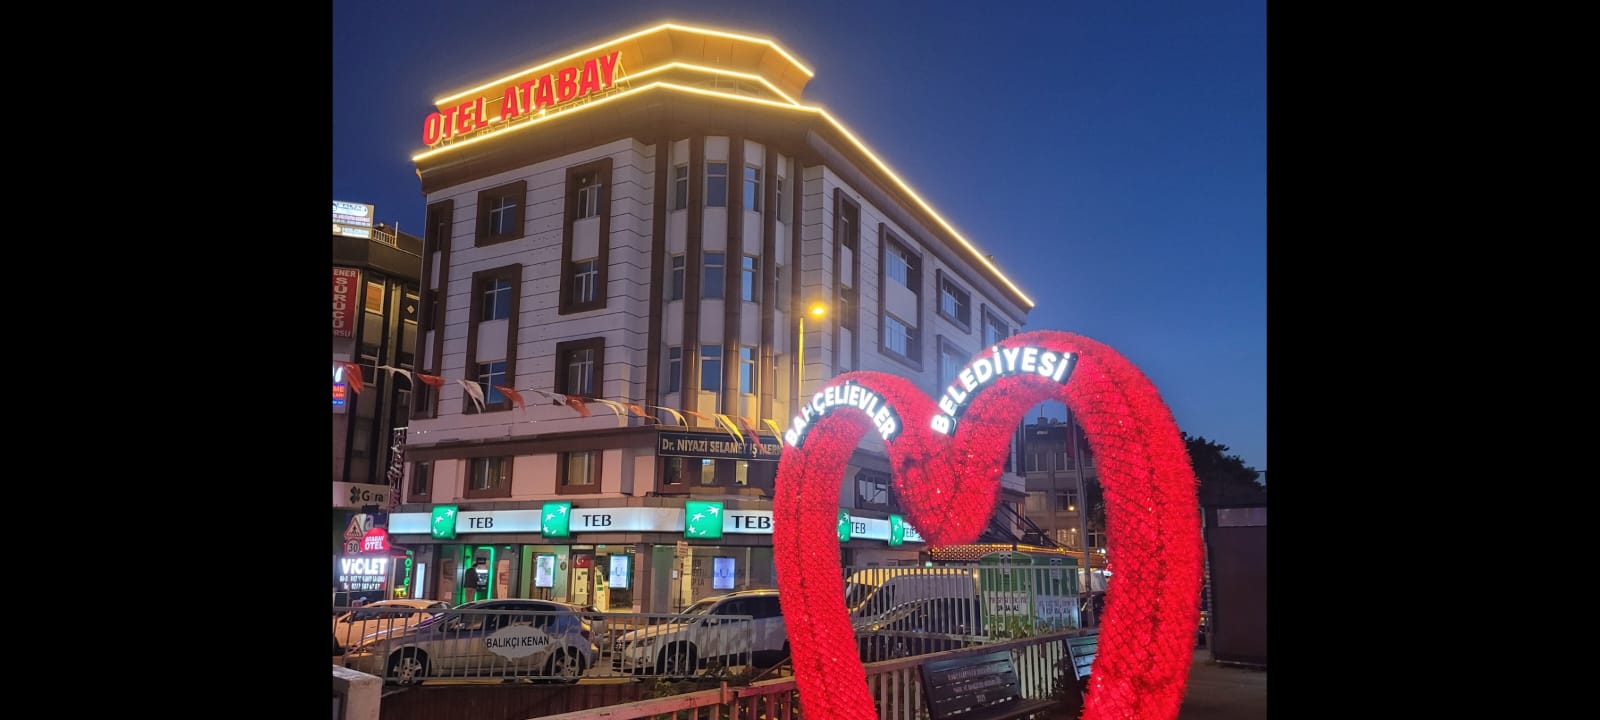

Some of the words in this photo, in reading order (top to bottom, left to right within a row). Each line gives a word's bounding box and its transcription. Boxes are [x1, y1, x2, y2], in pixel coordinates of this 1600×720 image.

[423, 97, 489, 146] OTEL
[501, 51, 621, 121] ATABAY
[931, 345, 1072, 434] BELEDİYESİ
[785, 380, 896, 447] BAHÇELİEVLER
[662, 438, 674, 451] Dr.
[677, 436, 708, 452] NİYAZİ
[362, 490, 384, 502] Gra
[468, 516, 494, 530] TEB
[582, 513, 612, 527] TEB
[731, 515, 771, 529] TEB
[851, 521, 866, 533] TEB
[348, 543, 358, 553] 30
[364, 542, 384, 551] OTEL
[486, 636, 520, 649] BALIKÇI
[521, 636, 550, 646] KENAN
